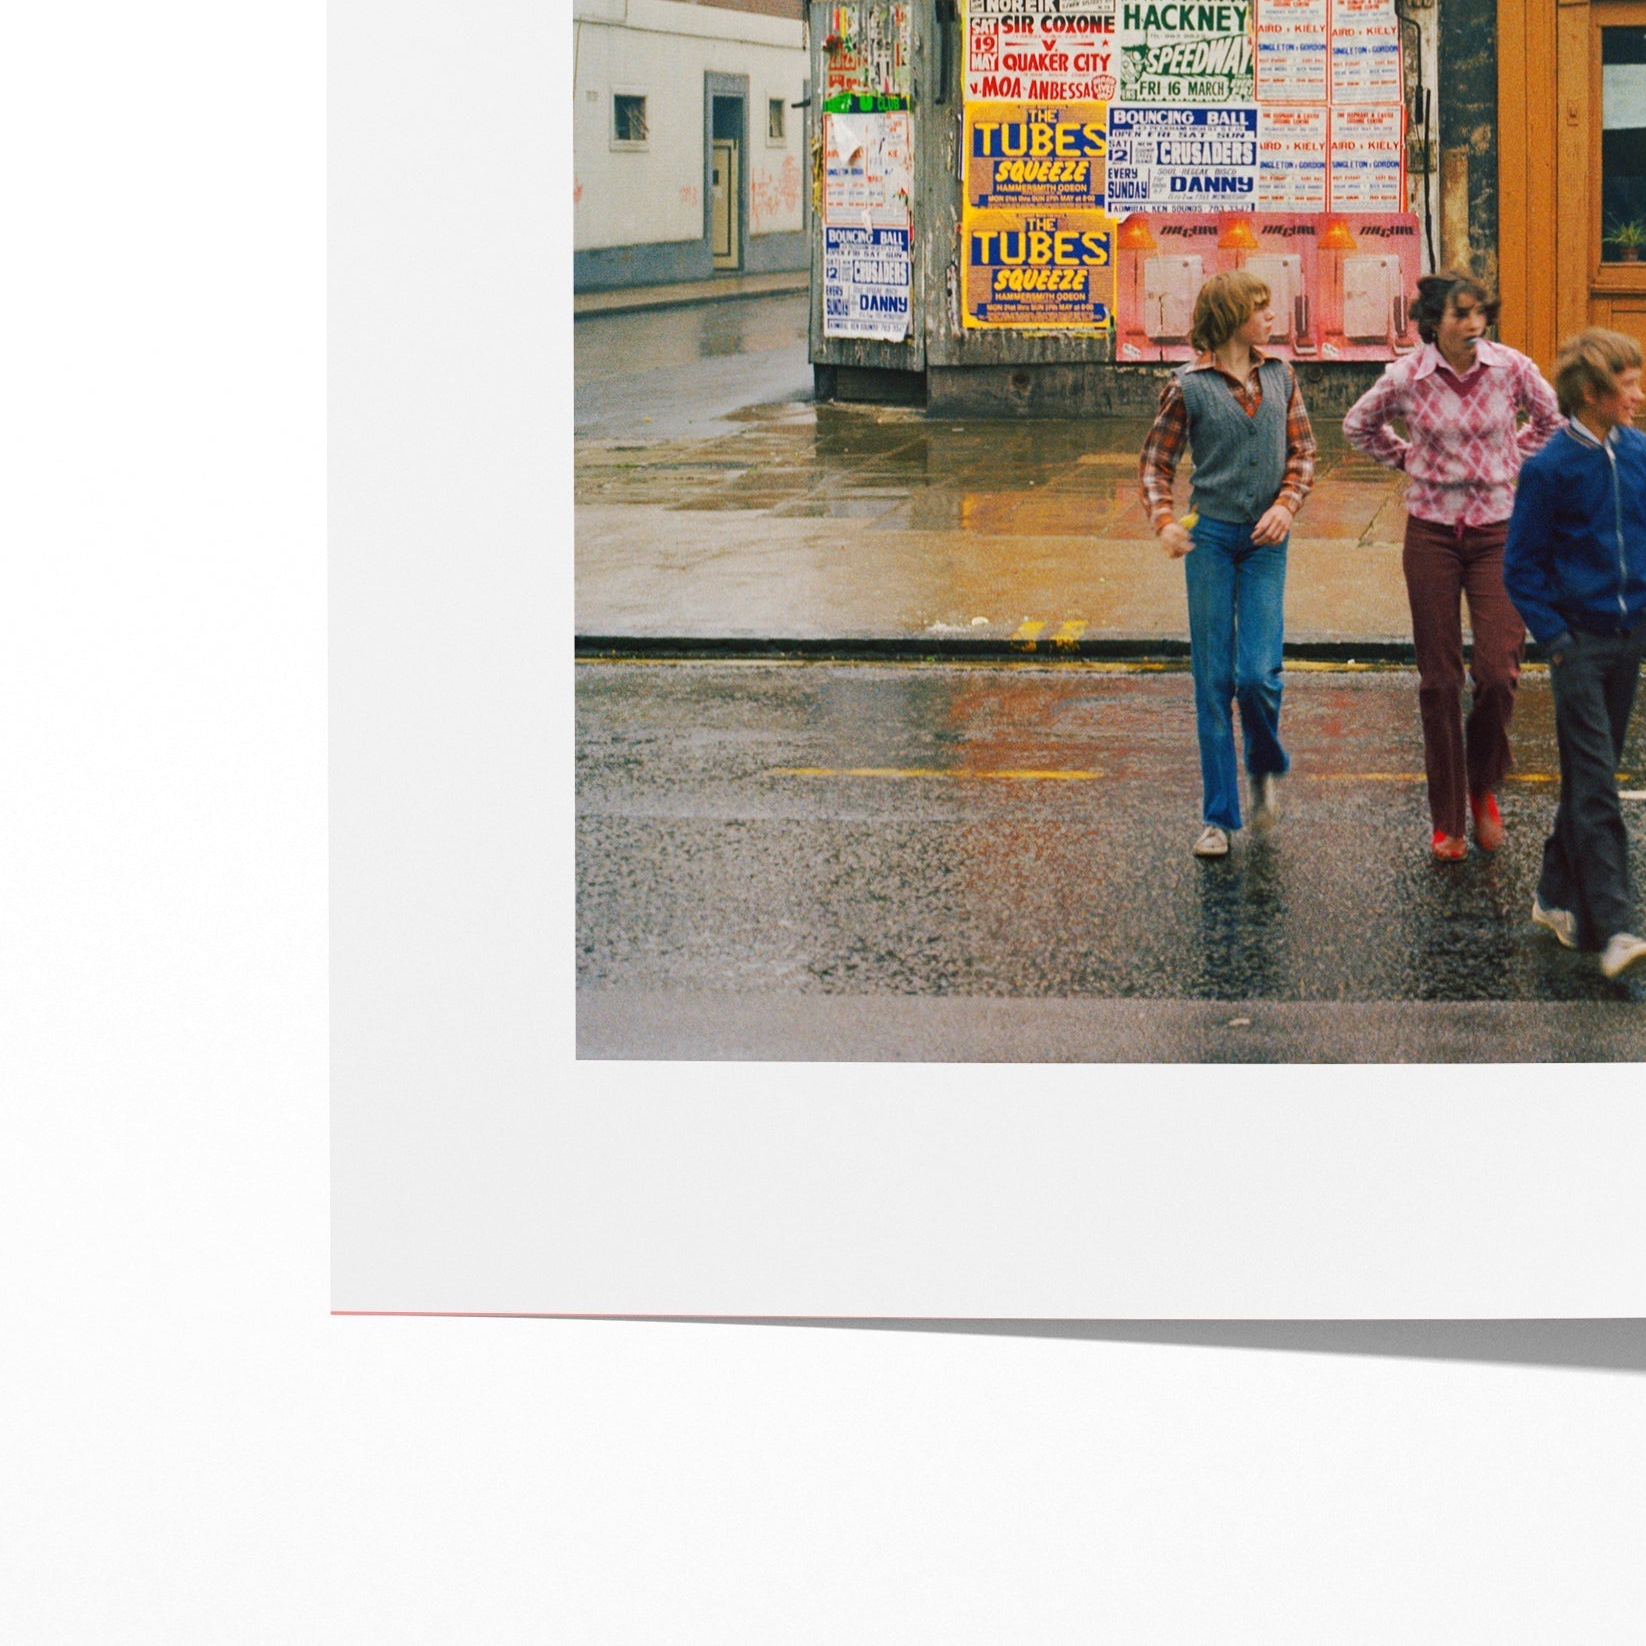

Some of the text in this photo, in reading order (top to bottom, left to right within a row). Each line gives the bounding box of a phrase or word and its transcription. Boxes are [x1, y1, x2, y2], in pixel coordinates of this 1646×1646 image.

[1001, 15, 1115, 34] SIR COXONE
[1124, 4, 1248, 32] HACKNEY
[972, 18, 997, 34] SAT
[1258, 24, 1282, 33] AIRD
[1294, 24, 1326, 33] KIELY
[1332, 28, 1355, 37] AIRD
[1366, 26, 1397, 36] KIELY
[974, 36, 996, 52] 19
[1258, 43, 1294, 52] SINGLETON
[1300, 43, 1326, 52] GORDON
[1332, 46, 1368, 55] SINGLETON
[1372, 44, 1398, 54] GORDON
[1145, 34, 1254, 74] SPEEDWAY
[972, 54, 998, 71] MAY
[1002, 53, 1112, 72] QUAKER CITY
[982, 76, 1022, 98] MOA
[1028, 80, 1090, 100] ANBESSA
[1140, 82, 1160, 96] FRI
[1168, 82, 1181, 96] 16
[1188, 82, 1224, 96] MARCH
[878, 97, 900, 111] CLUB
[1028, 110, 1058, 123] THE
[1113, 110, 1194, 125] BOUNCING
[1206, 110, 1249, 126] BALL
[974, 122, 1106, 156] TUBES
[1108, 140, 1128, 148] SAT
[1294, 142, 1326, 151] KIELY
[1332, 142, 1356, 150] AIRD
[1368, 142, 1399, 150] KIELY
[1108, 150, 1128, 161] 12
[1160, 142, 1254, 164] CRUSADERS
[994, 160, 1090, 183] SQUEEZE
[1299, 161, 1326, 169] GORDON
[1332, 160, 1368, 168] SINGLETON
[1373, 160, 1400, 168] GORDON
[1108, 168, 1138, 179] EVERY
[996, 184, 1087, 192] HAMMERSMITH ODEON
[1108, 181, 1147, 199] SUNDAY
[1170, 176, 1254, 192] DANNY
[1114, 204, 1146, 212] ADMIRAL
[1152, 204, 1168, 212] KEN
[1172, 204, 1202, 212] SOUNDS
[1026, 218, 1056, 232] THE
[828, 229, 904, 246] BOUNCING BALL
[973, 232, 1108, 266] TUBES
[826, 267, 838, 279] 12
[854, 260, 906, 285] CRUSADERS
[993, 269, 1088, 292] SQUEEZE
[860, 294, 908, 313] DANNY
[995, 293, 1086, 301] HAMMERSMITH ODEON
